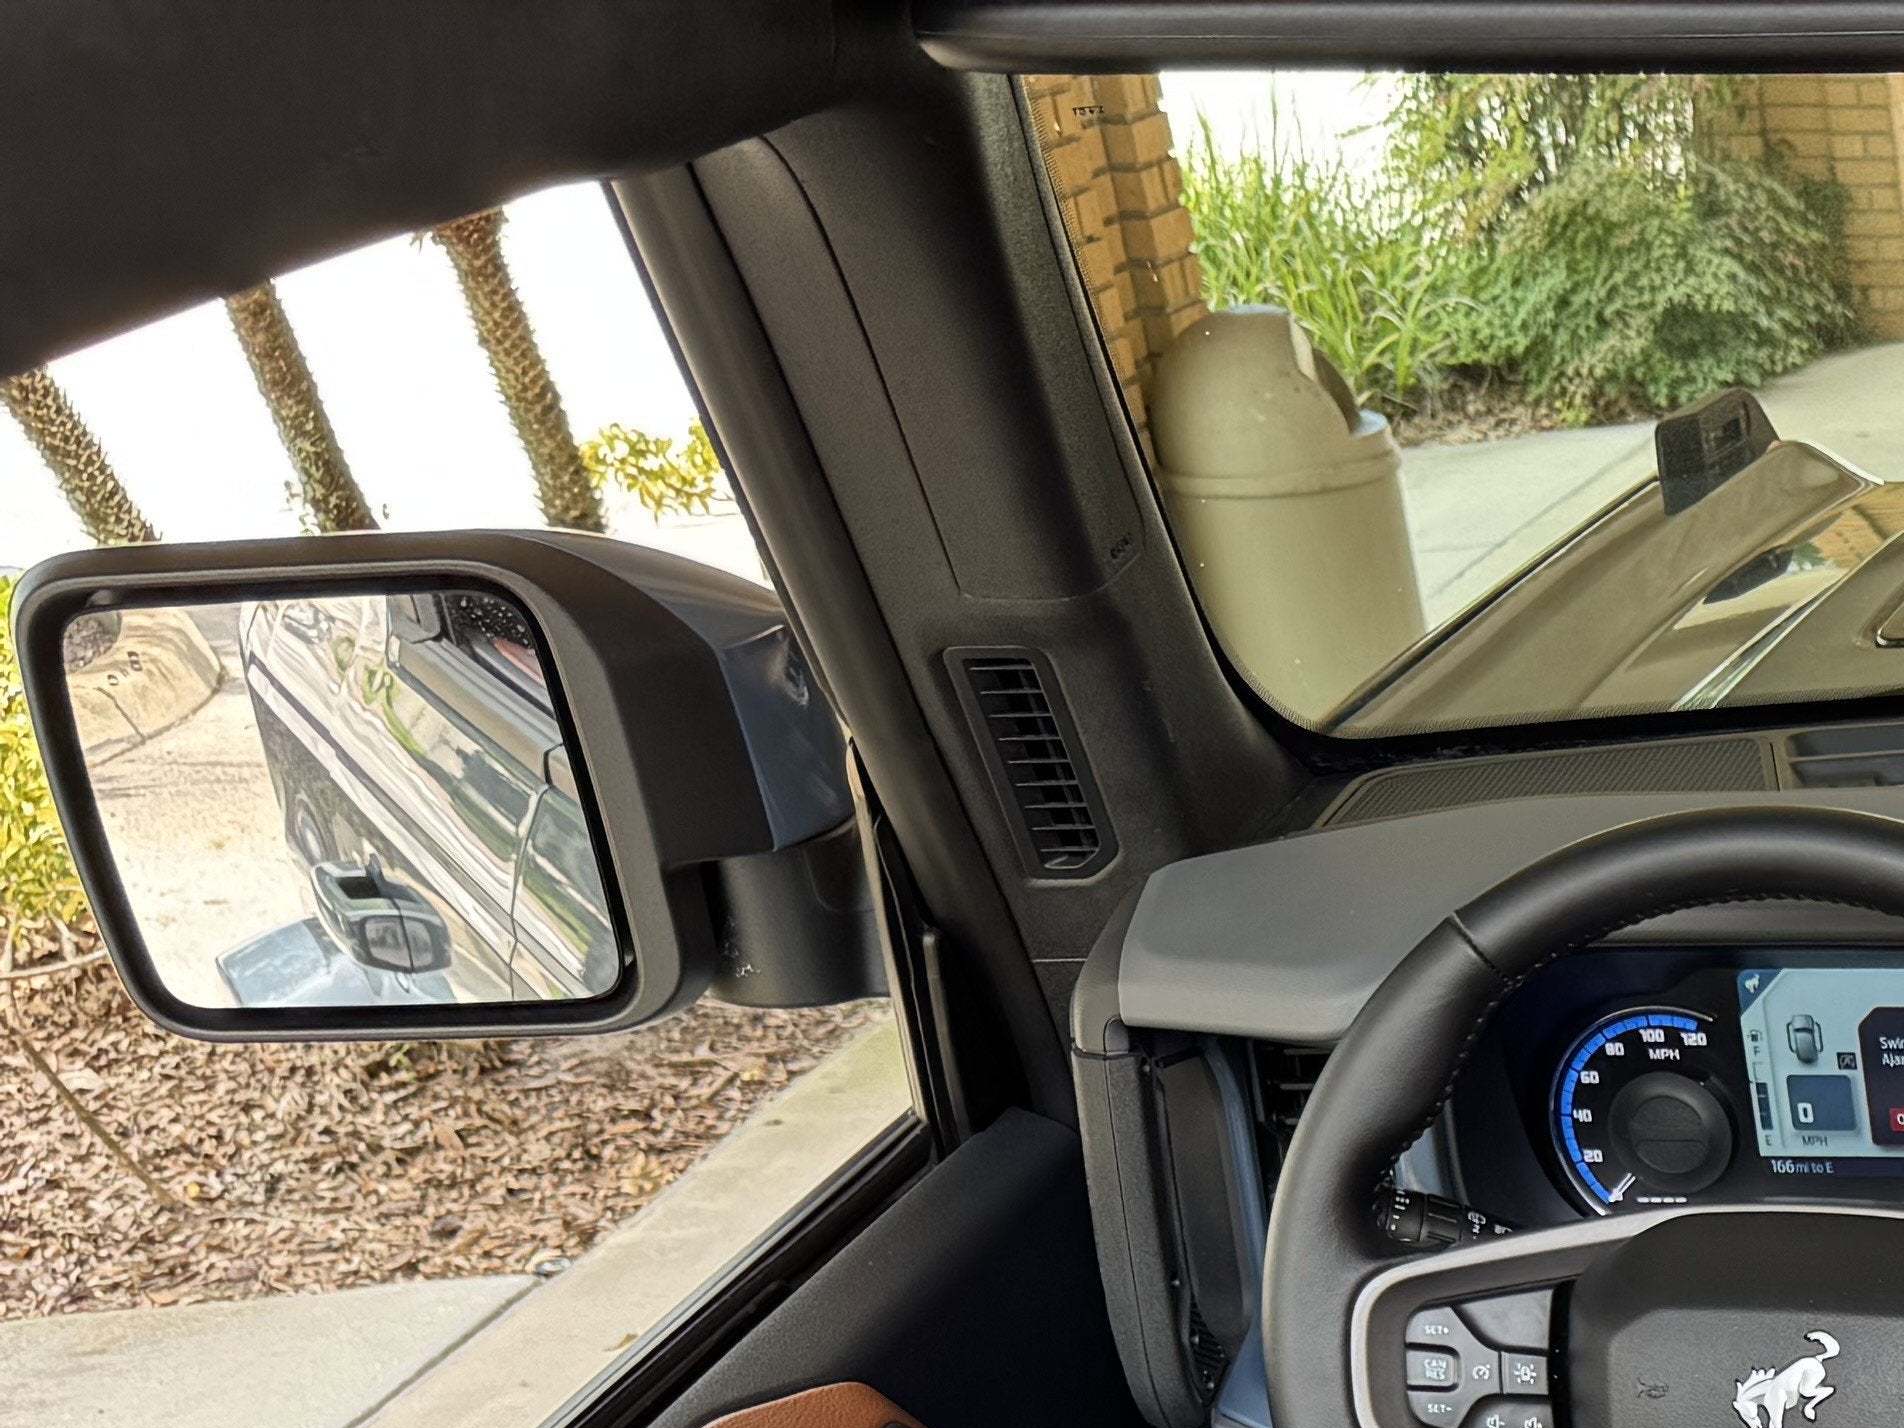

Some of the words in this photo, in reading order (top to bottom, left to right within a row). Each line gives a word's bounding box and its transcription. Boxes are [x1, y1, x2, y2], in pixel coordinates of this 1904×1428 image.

[1639, 1028, 1665, 1043] 100
[1680, 1032, 1707, 1046] 120
[1605, 1042, 1625, 1056] 80
[1648, 1048, 1681, 1061] MPH
[1580, 1070, 1600, 1084] 60
[1573, 1108, 1593, 1123] 40
[1797, 1102, 1814, 1124] 0
[1801, 1135, 1829, 1147] MPH
[1583, 1149, 1603, 1163] 20
[1771, 1159, 1795, 1174] 166
